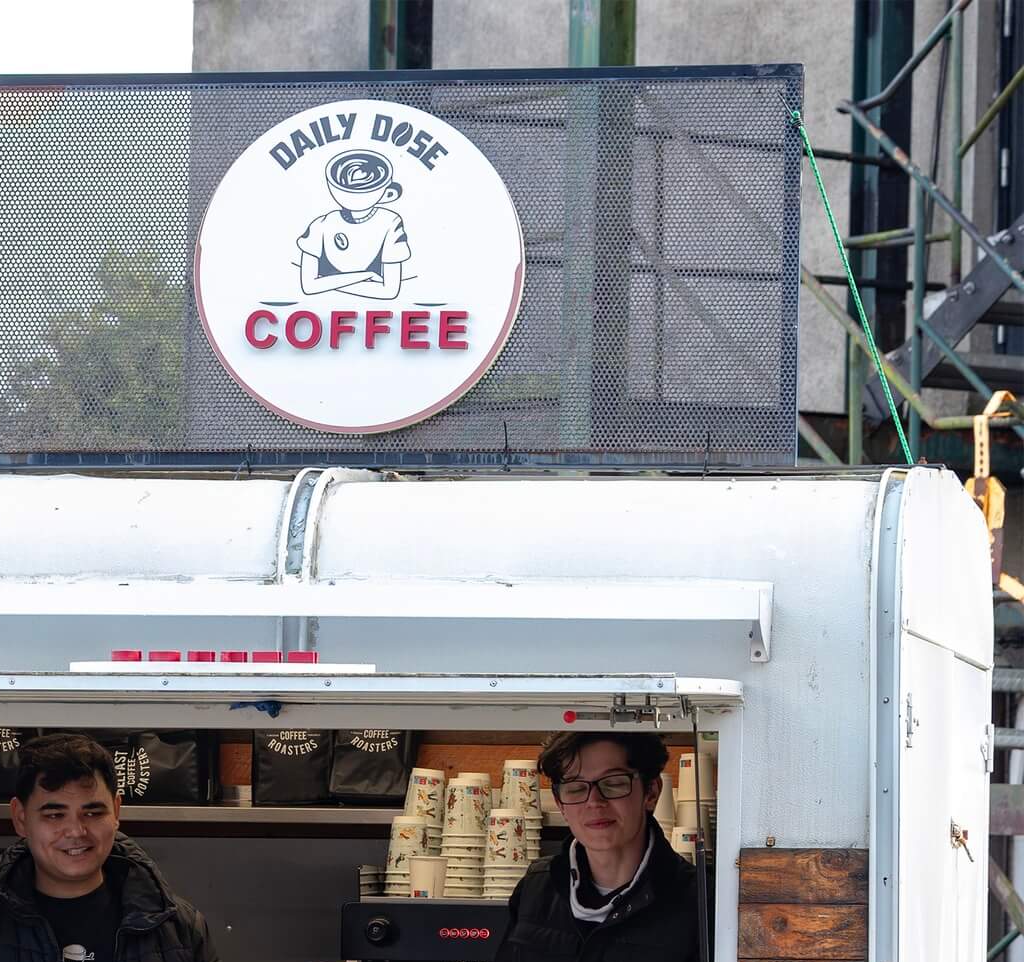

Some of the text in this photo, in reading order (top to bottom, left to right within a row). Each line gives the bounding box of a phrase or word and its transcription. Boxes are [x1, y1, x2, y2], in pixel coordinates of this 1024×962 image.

[268, 112, 357, 171] DAILY
[245, 310, 469, 350] COFFEE
[279, 730, 308, 741] COFFEE
[349, 735, 398, 753] ROASTERS
[363, 729, 389, 739] COFFEE
[267, 738, 318, 756] ROASTERS
[127, 758, 136, 785] COFFEE
[134, 747, 150, 797] ROASTERS
